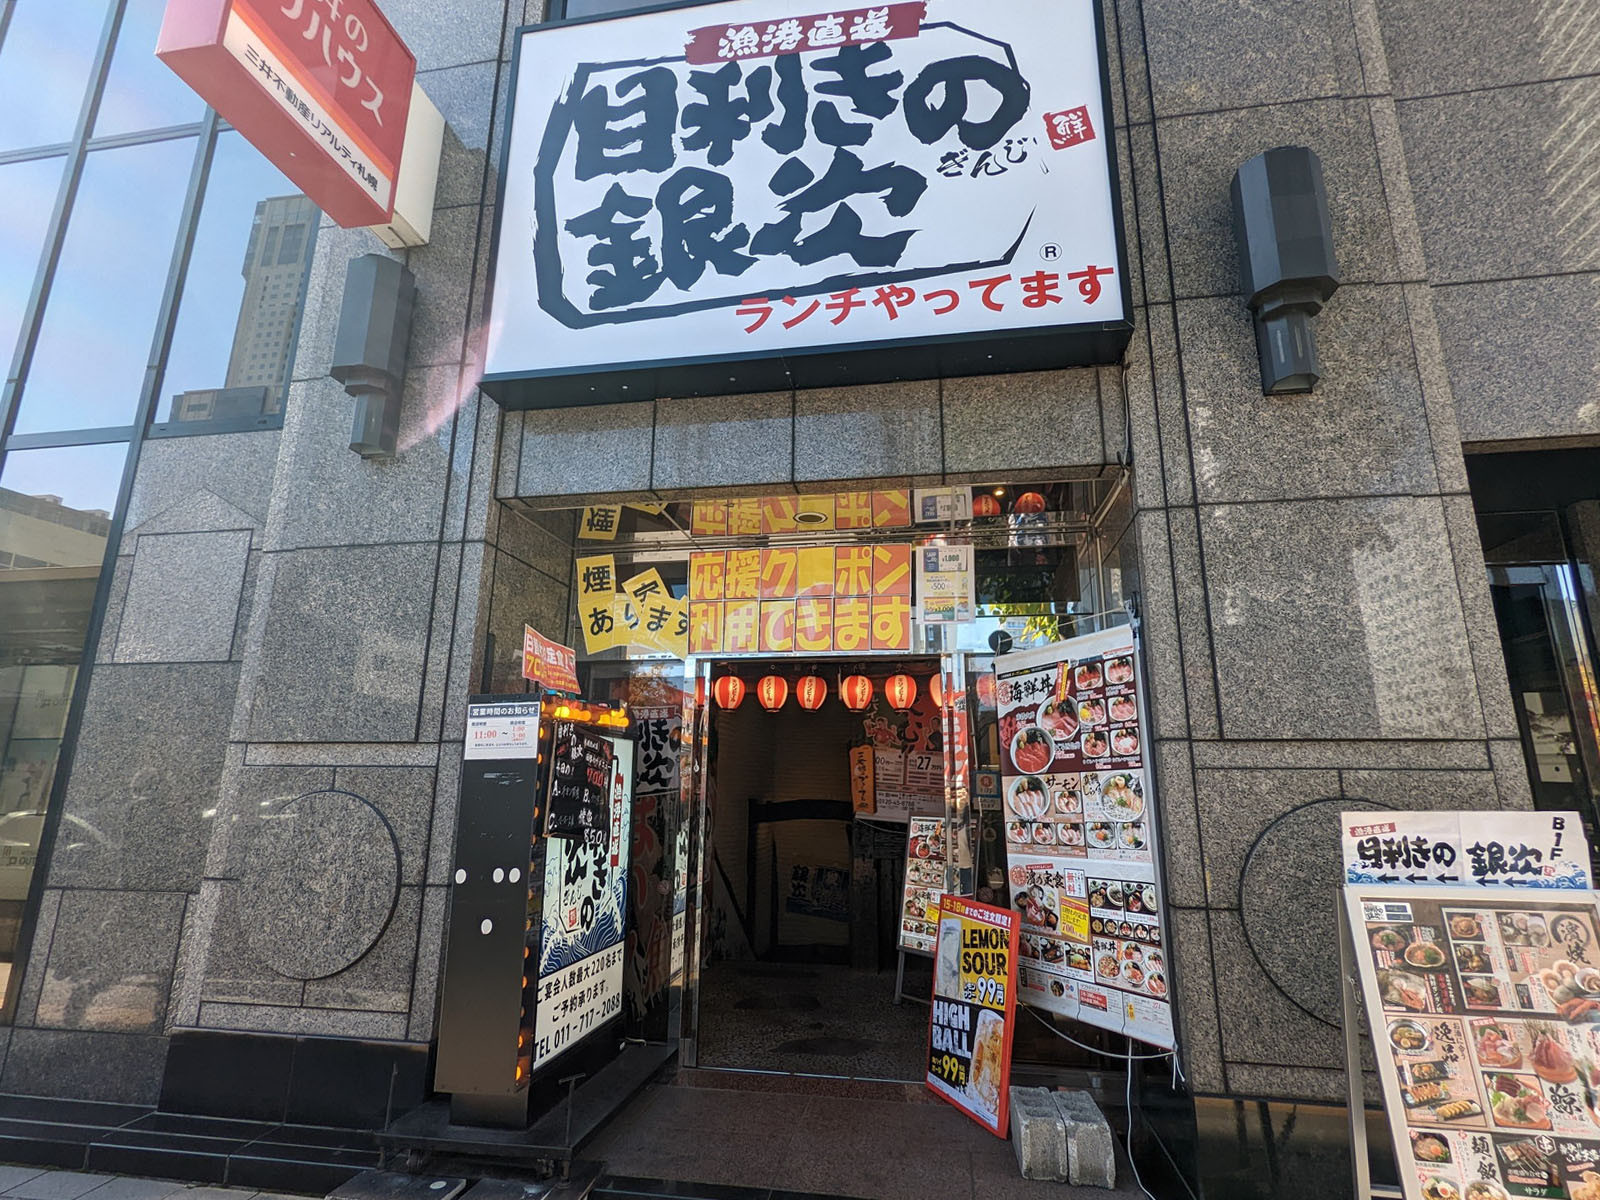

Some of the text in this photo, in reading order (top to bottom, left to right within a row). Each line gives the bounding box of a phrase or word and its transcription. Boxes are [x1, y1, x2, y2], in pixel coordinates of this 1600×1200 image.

[717, 10, 896, 57] 漁港直送
[243, 43, 379, 193] 三井不動産リアルティ札幌
[574, 40, 1032, 182] 目利きの
[563, 147, 928, 311] 銀次
[735, 265, 1115, 335] ランチやってます
[689, 598, 910, 652] 利用できます
[1010, 673, 1053, 702] 海鮮丼
[472, 707, 535, 716] 営業時間のお知らせ
[474, 730, 497, 739] 11:00
[1046, 778, 1079, 790] サーモン
[1357, 835, 1542, 877] 目利きの 銀次
[963, 929, 1010, 950] LEMON
[536, 949, 622, 1003] ご宴会人数最大220名まで
[963, 952, 1008, 976] SOUR
[552, 979, 609, 1022] ご予約承ります。
[933, 1000, 970, 1031] HIGH
[533, 992, 621, 1062] TEL 011-717-2088
[932, 1025, 972, 1059] BALL
